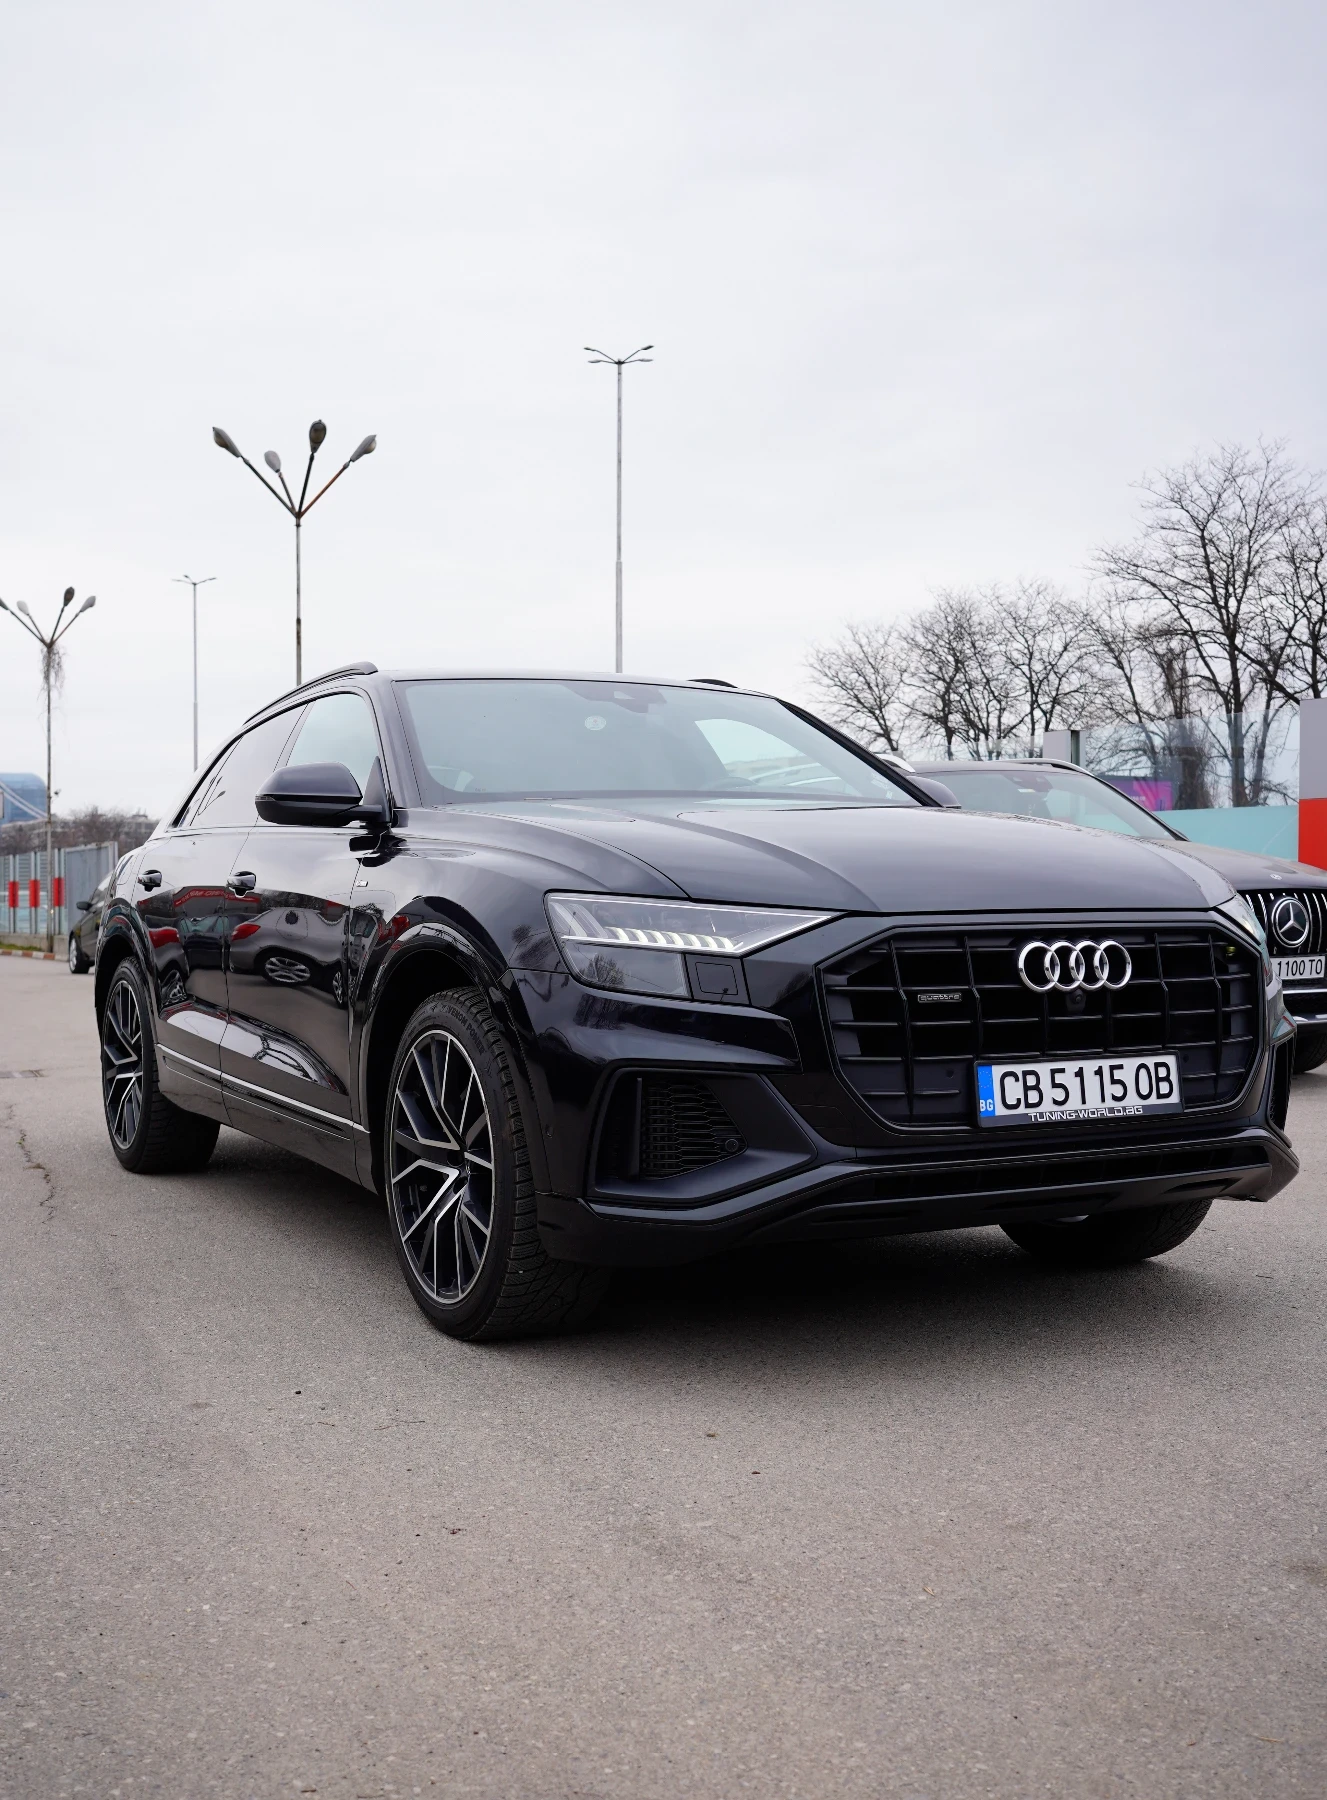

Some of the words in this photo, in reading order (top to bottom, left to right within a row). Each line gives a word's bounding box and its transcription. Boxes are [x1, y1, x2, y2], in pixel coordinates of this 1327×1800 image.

[1277, 960, 1306, 976] 1100
[1308, 959, 1323, 976] TO
[980, 1099, 994, 1112] BG
[1028, 1105, 1143, 1122] TUNING-WORLD.BG
